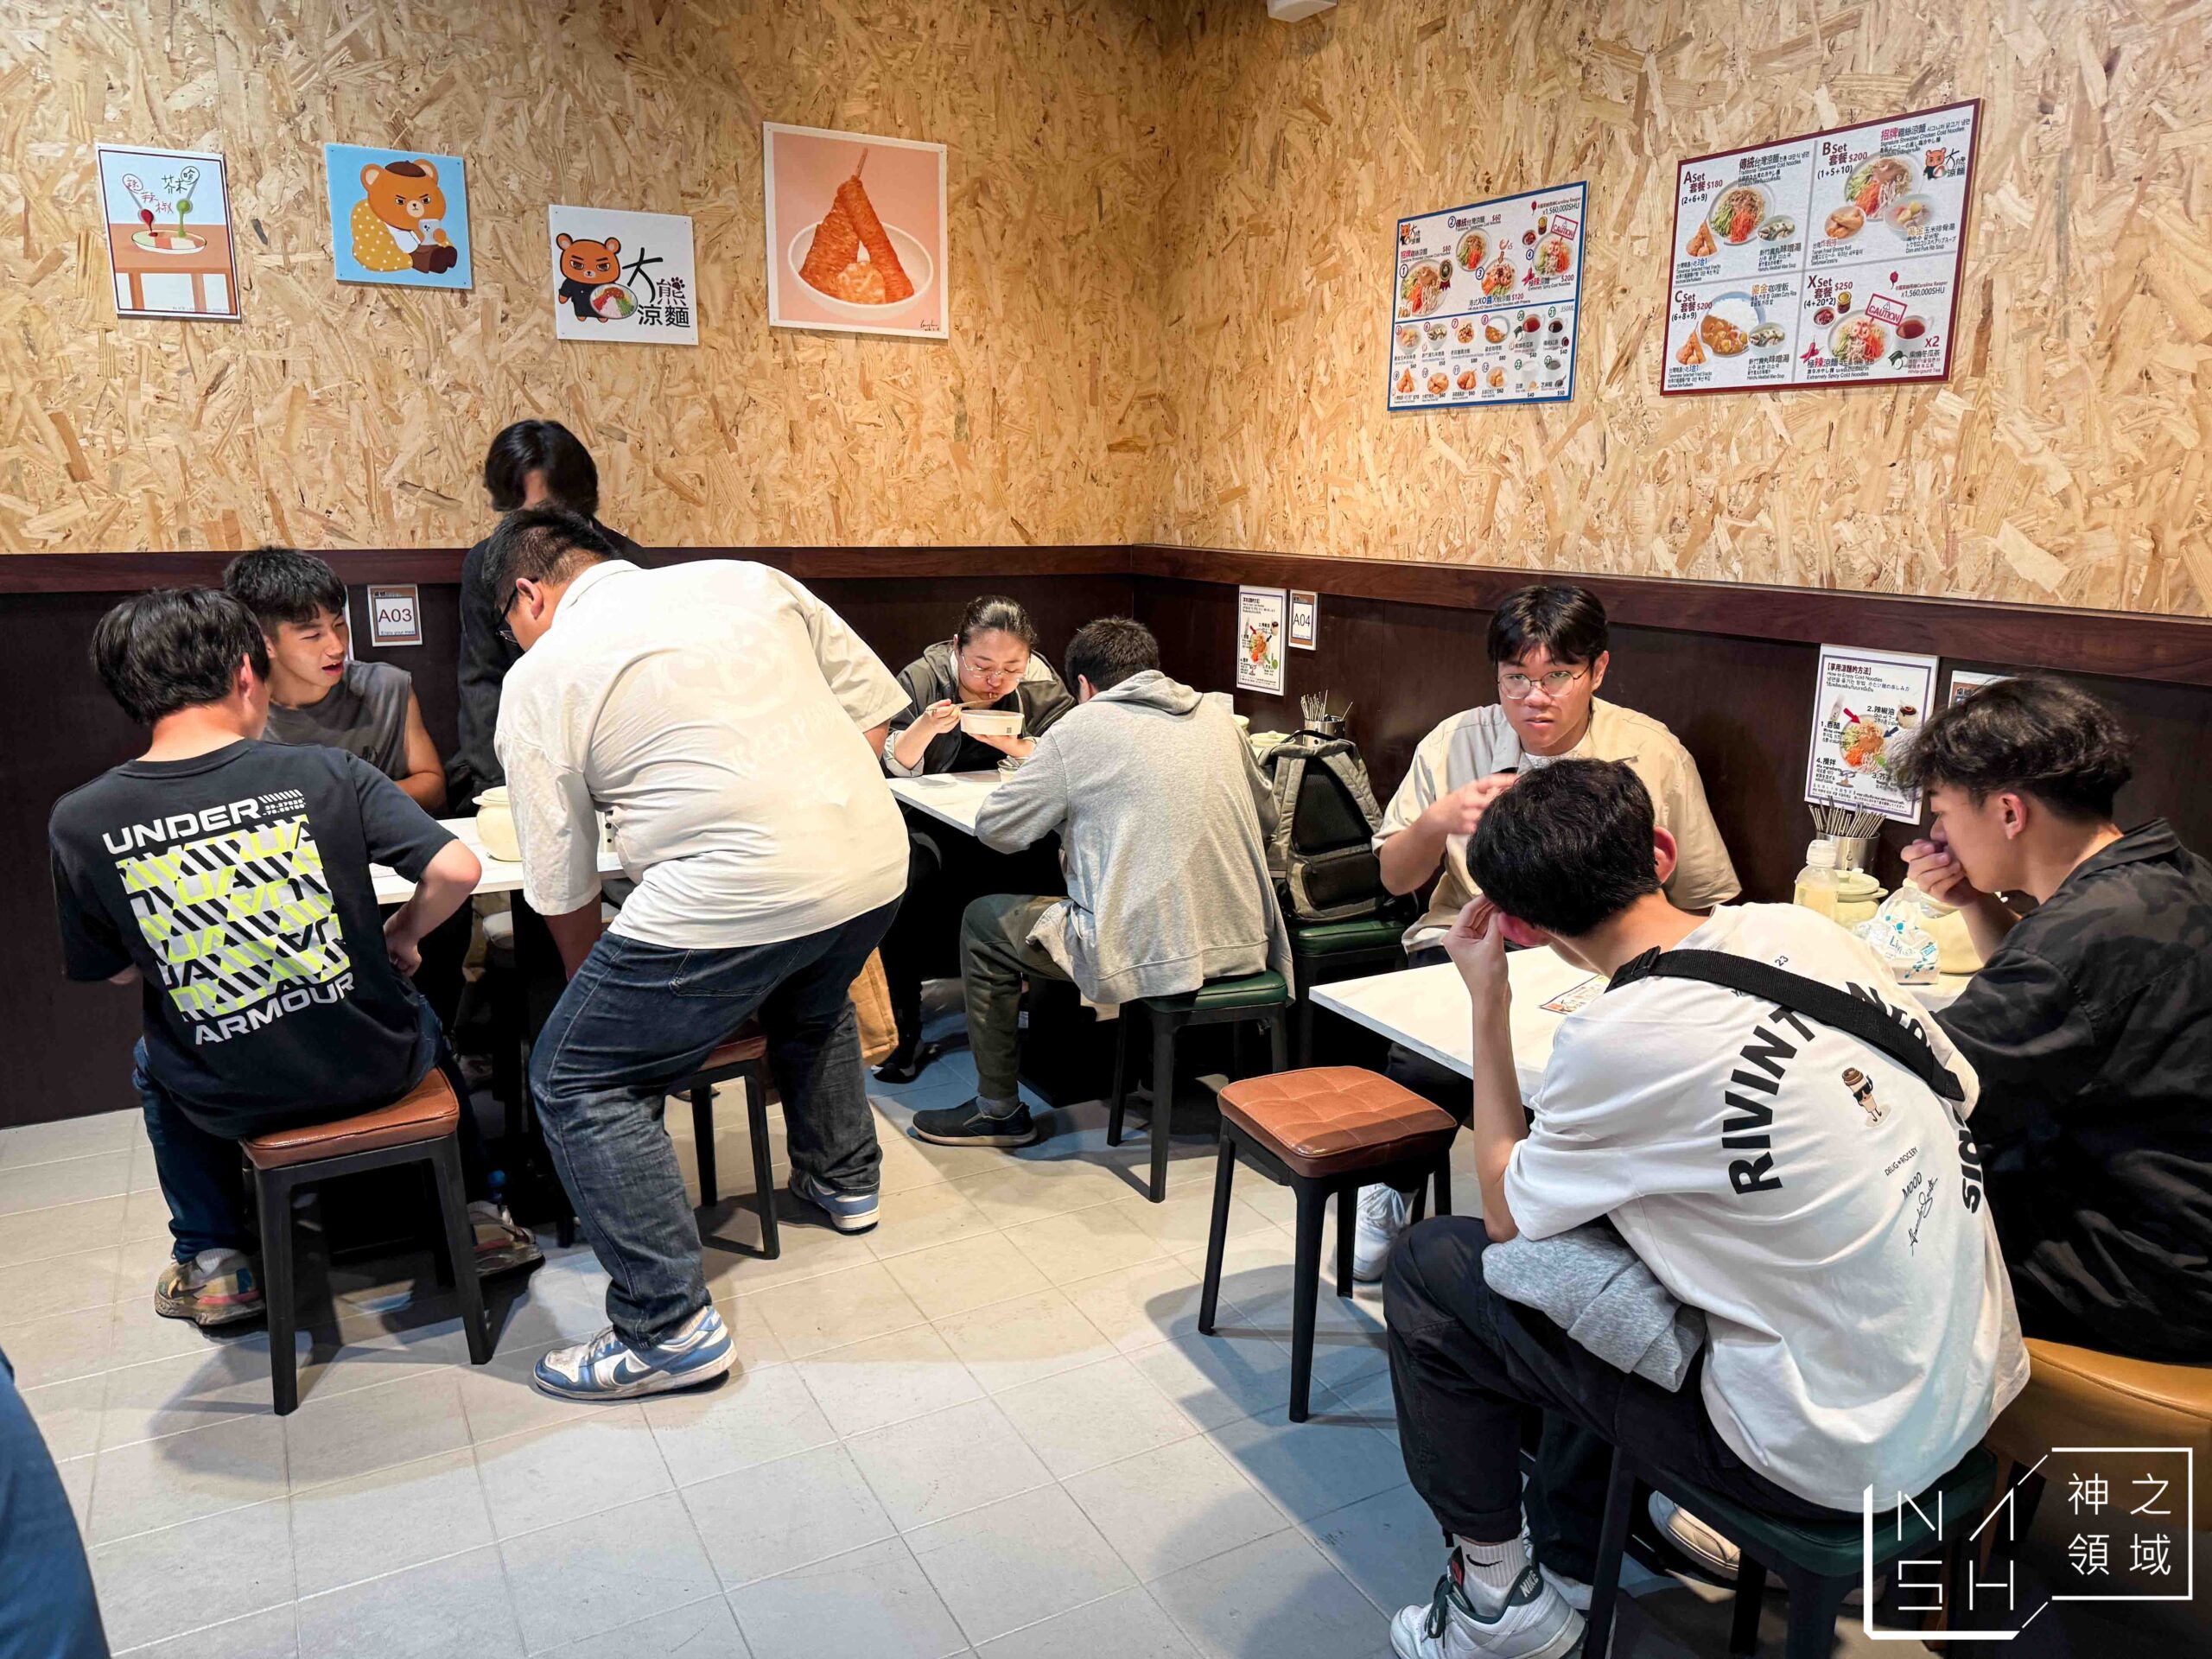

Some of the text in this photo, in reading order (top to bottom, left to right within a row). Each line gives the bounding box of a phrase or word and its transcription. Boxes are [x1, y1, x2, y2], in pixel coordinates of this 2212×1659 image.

[1832, 143, 1847, 154] Set
[1828, 152, 1847, 166] 套餐
[1848, 152, 1867, 162] $200
[1692, 173, 1705, 182] Set
[1817, 165, 1853, 180] (1+5+10)
[1689, 179, 1723, 193] 套餐 $180
[1681, 193, 1707, 206] (2+6+9)
[1553, 224, 1574, 238] CAUTION
[622, 247, 686, 307] 大熊
[1808, 274, 1853, 291] X Set $250
[1683, 293, 1695, 302] Set
[1814, 287, 1833, 299] 套餐
[1681, 302, 1713, 312] 套餐 $200
[1868, 305, 1901, 322] CAUTION
[638, 303, 690, 328] 涼麵
[1672, 312, 1697, 321] (6+8+9)
[378, 608, 412, 623] A03
[1294, 613, 1311, 627] A04
[102, 798, 262, 855] UNDER
[1774, 955, 1789, 967] 23
[195, 972, 355, 1046] ARMOUR
[1902, 1172, 1923, 1200] MOOD
